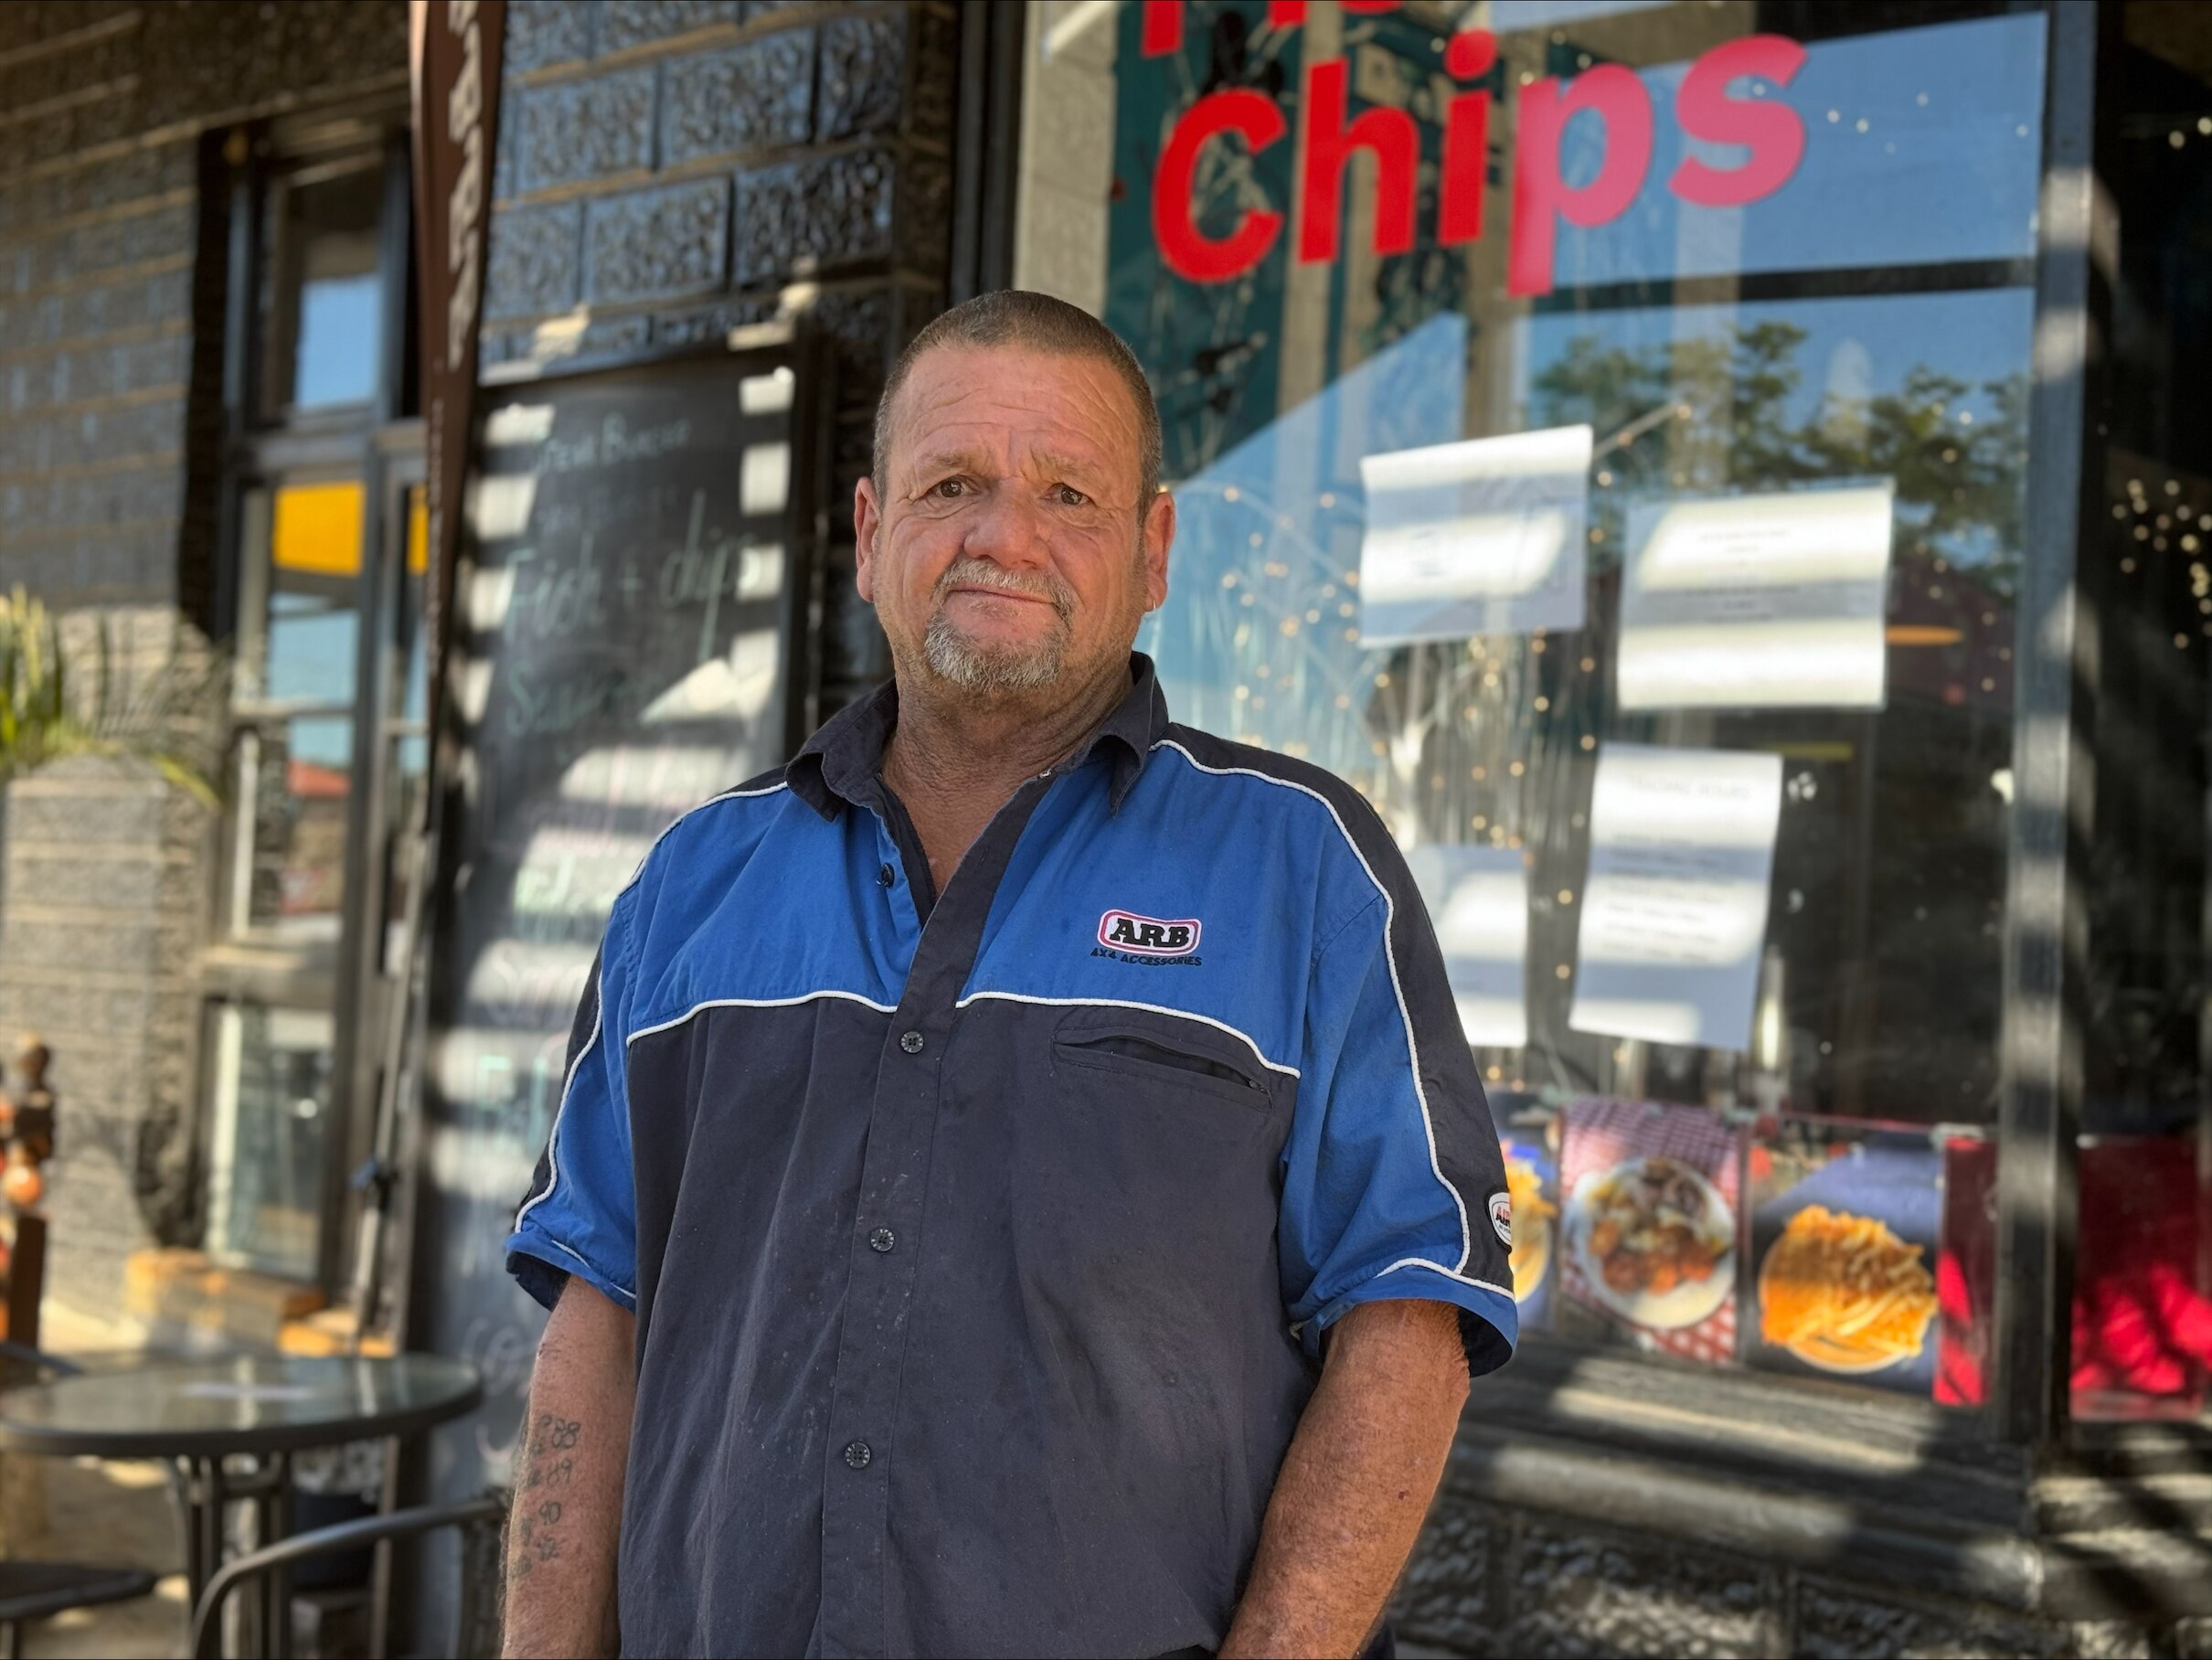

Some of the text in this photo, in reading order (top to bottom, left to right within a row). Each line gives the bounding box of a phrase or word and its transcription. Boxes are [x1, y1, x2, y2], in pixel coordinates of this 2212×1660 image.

[1153, 33, 1808, 298] chips
[1109, 918, 1191, 948] ARB
[1120, 952, 1203, 967] ACCESSORIES
